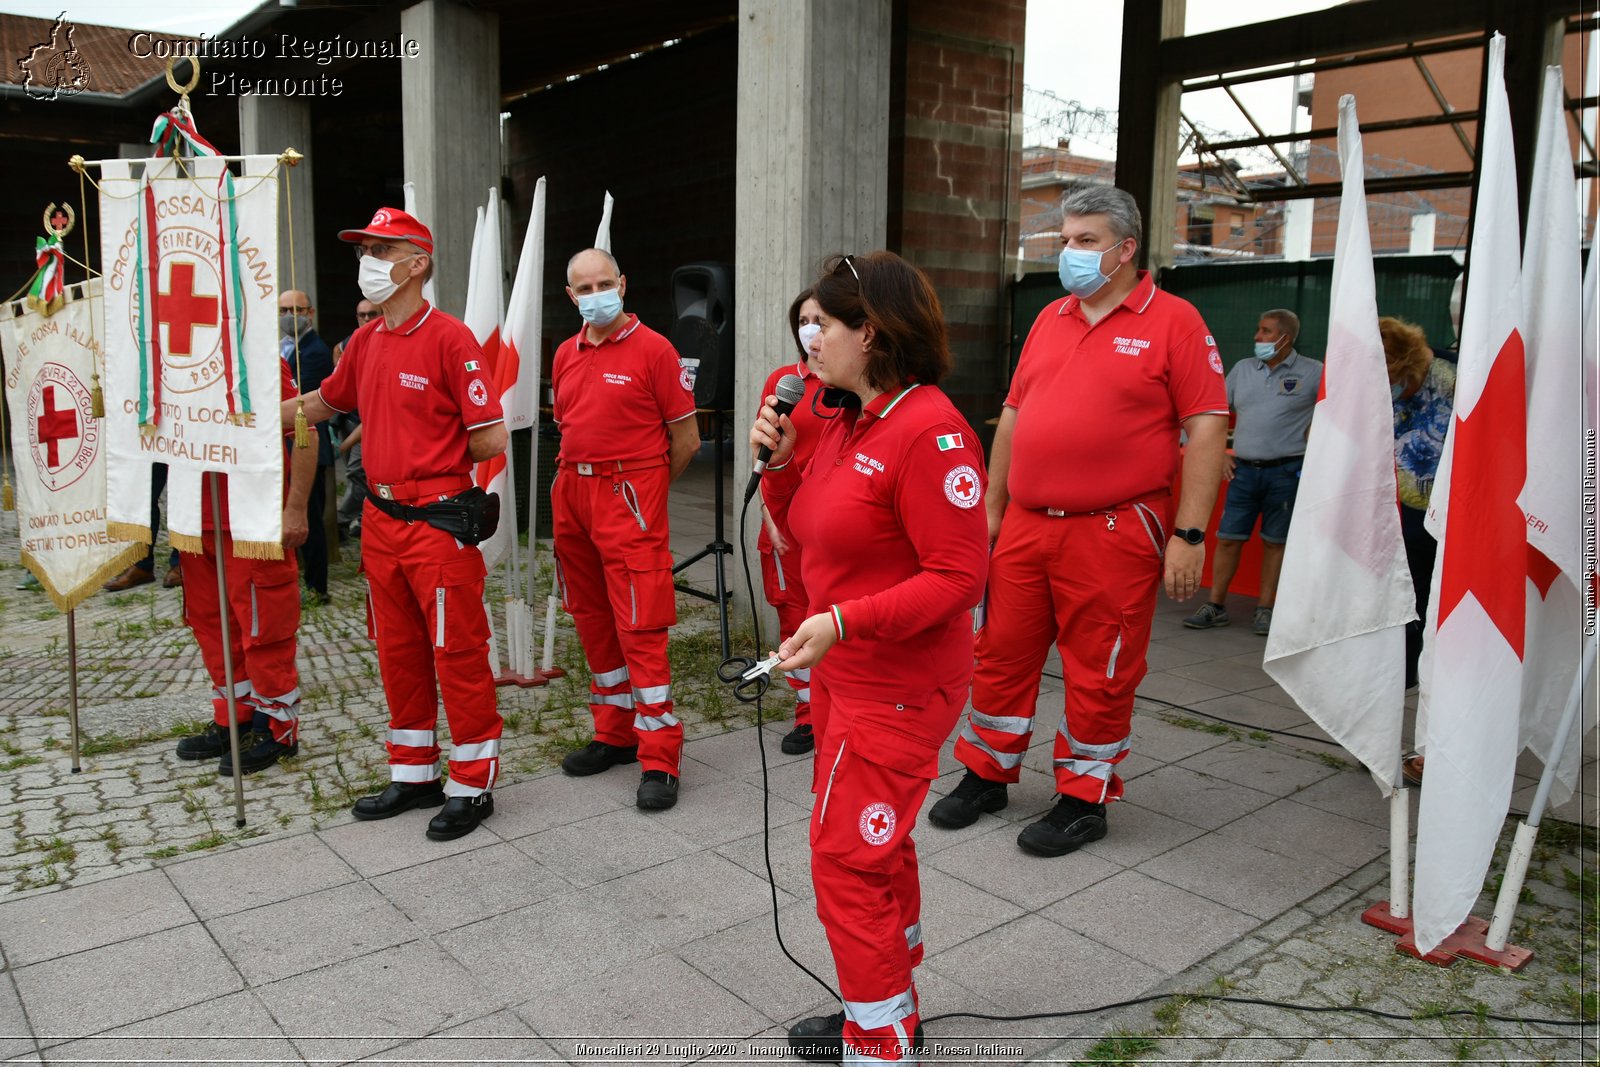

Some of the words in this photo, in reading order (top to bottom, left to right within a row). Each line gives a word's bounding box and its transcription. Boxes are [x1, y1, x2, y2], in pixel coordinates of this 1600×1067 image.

[155, 195, 205, 222] OSSA
[1113, 336, 1131, 346] CROCE
[1131, 339, 1151, 349] ROSSA
[1115, 345, 1141, 357] ITALIANA
[67, 376, 78, 392] 22
[75, 389, 98, 443] AGOSTO
[173, 423, 184, 440] DI
[74, 445, 94, 470] 1864
[140, 436, 238, 465] MONCALIERI
